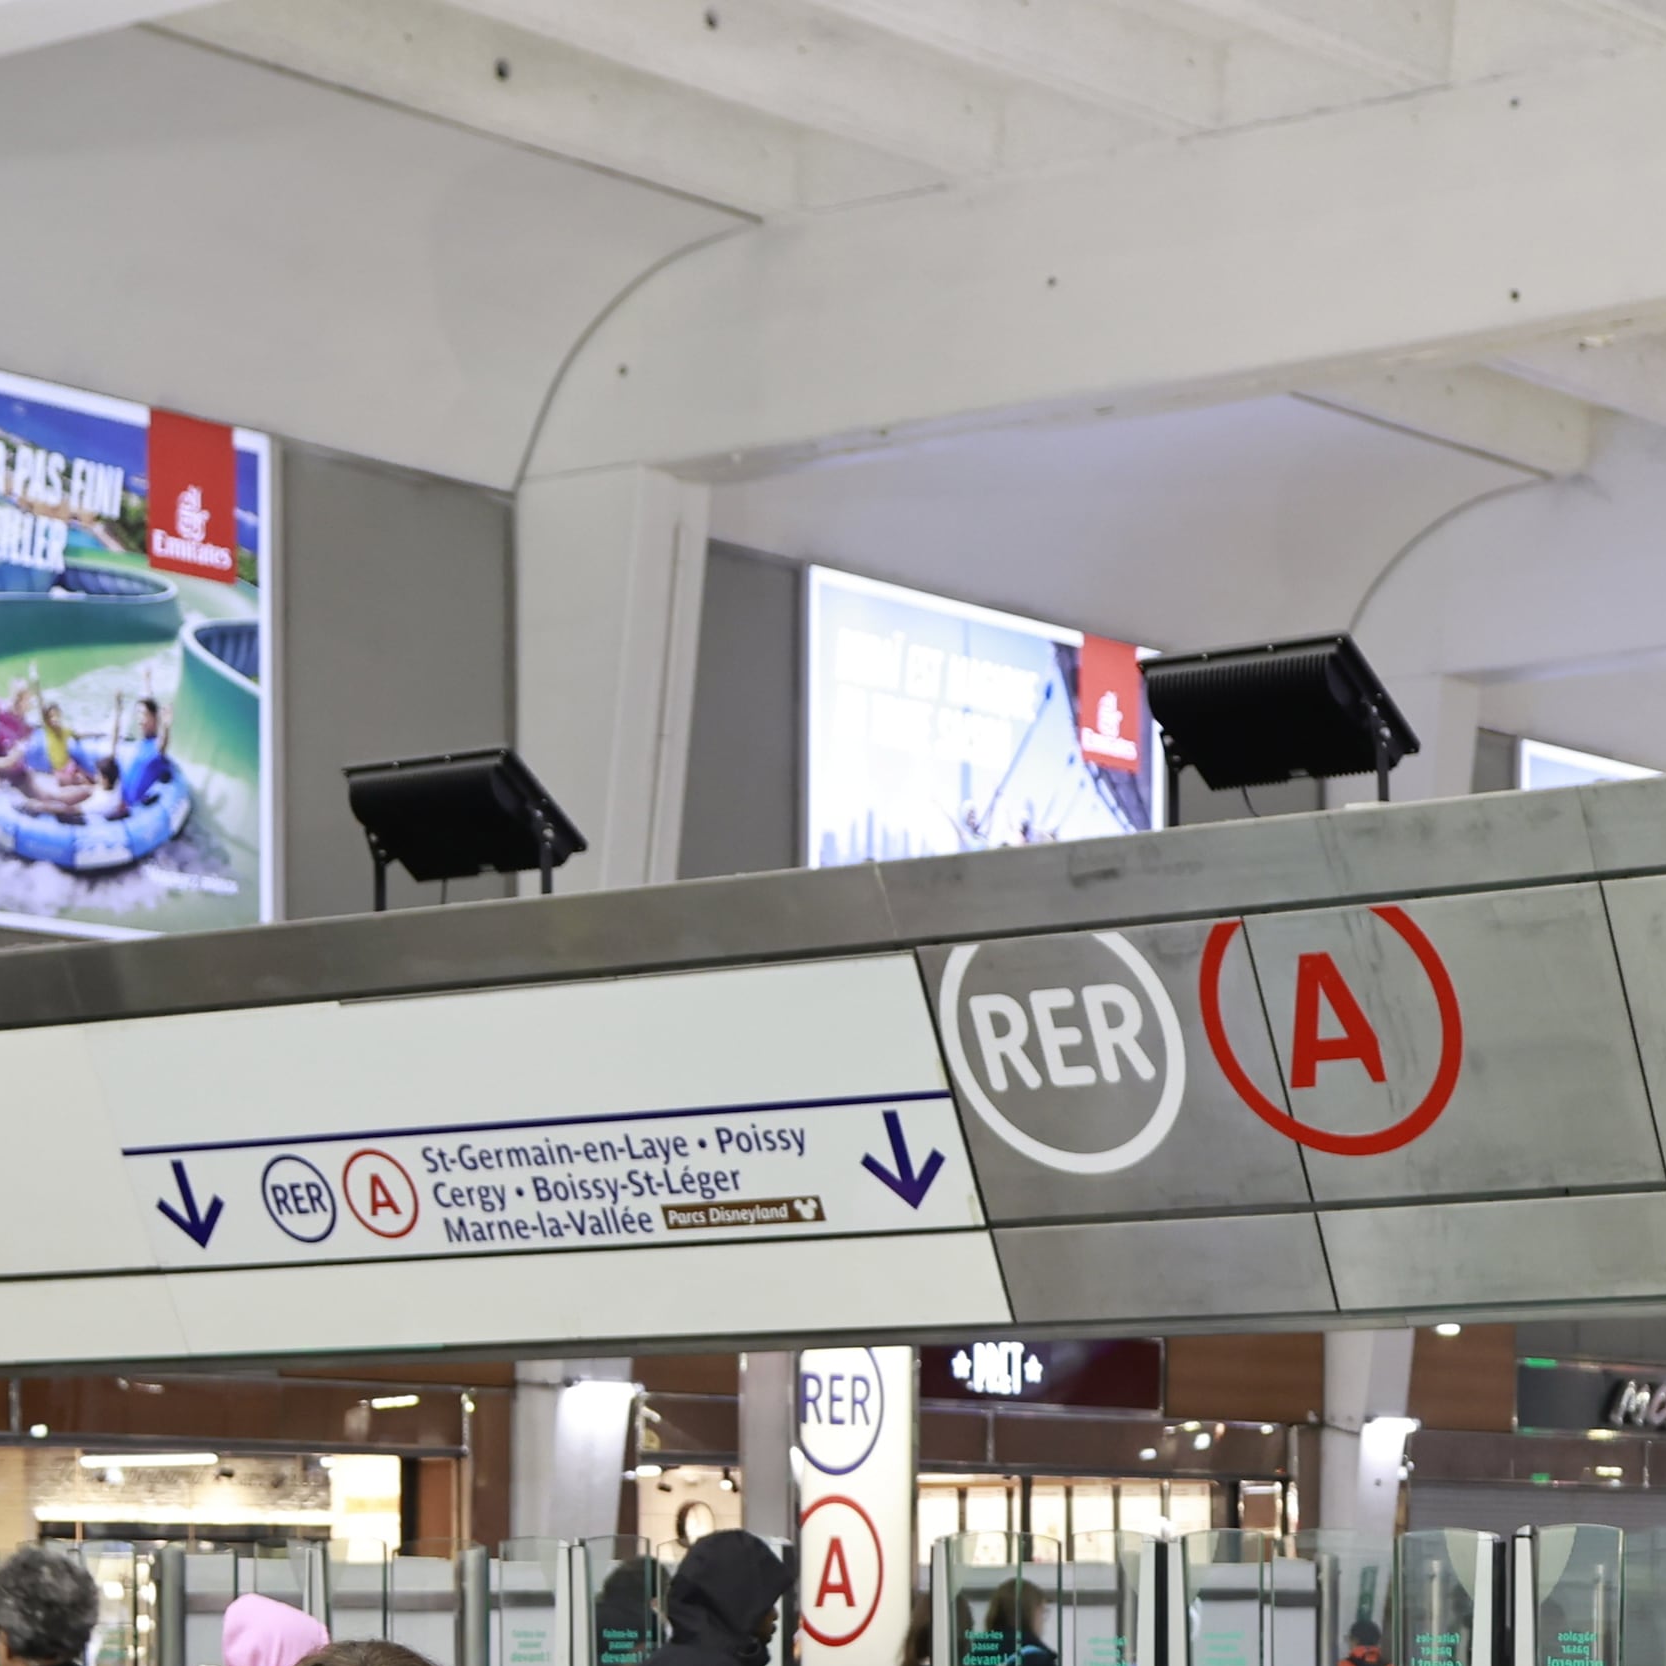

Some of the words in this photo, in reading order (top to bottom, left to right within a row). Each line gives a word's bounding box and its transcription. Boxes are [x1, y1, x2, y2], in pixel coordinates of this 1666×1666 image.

[13, 444, 67, 507] PAS
[69, 456, 125, 521] FINI
[151, 528, 232, 570] Emirates
[968, 982, 1157, 1092] RER
[1289, 951, 1388, 1090] A
[421, 1132, 692, 1174] St-Germain-en-Laye
[714, 1123, 806, 1157] Poissy
[270, 1181, 329, 1216] RER
[369, 1173, 403, 1217] A
[432, 1180, 507, 1213] Cergy
[531, 1165, 742, 1204] Boissy-St-Léger
[442, 1206, 655, 1243] Marne-la-Vallée
[667, 1207, 707, 1226] Parcs
[708, 1202, 789, 1226] Disneyland
[800, 1373, 871, 1426] RER
[814, 1535, 857, 1608] A
